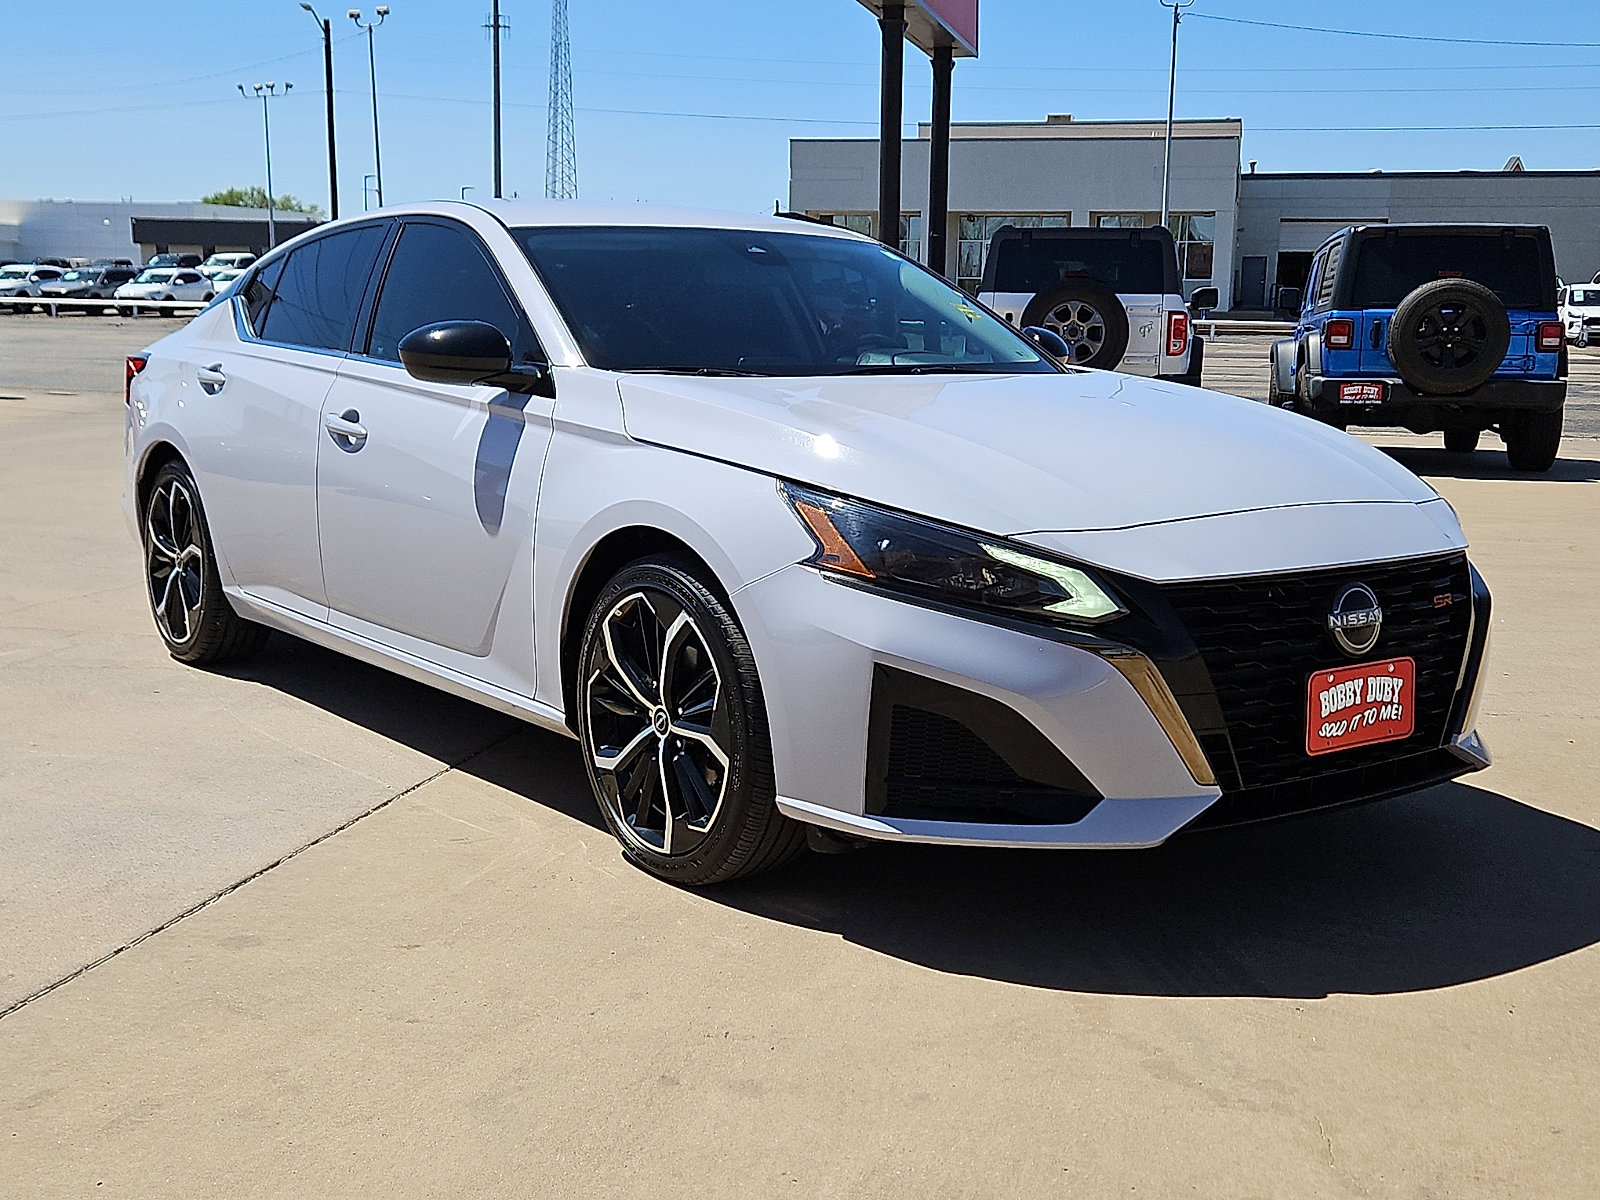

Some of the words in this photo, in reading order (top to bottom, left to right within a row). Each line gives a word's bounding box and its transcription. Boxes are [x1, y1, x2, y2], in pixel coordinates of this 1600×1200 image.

[1433, 593, 1452, 608] SR
[1330, 608, 1381, 627] NISSAN
[1319, 678, 1363, 717] BOBBY
[1367, 677, 1403, 703] DUBY
[1318, 719, 1348, 737] SOLD
[1348, 714, 1363, 733] IT
[1362, 707, 1378, 727] TO
[1379, 704, 1403, 722] ME!
